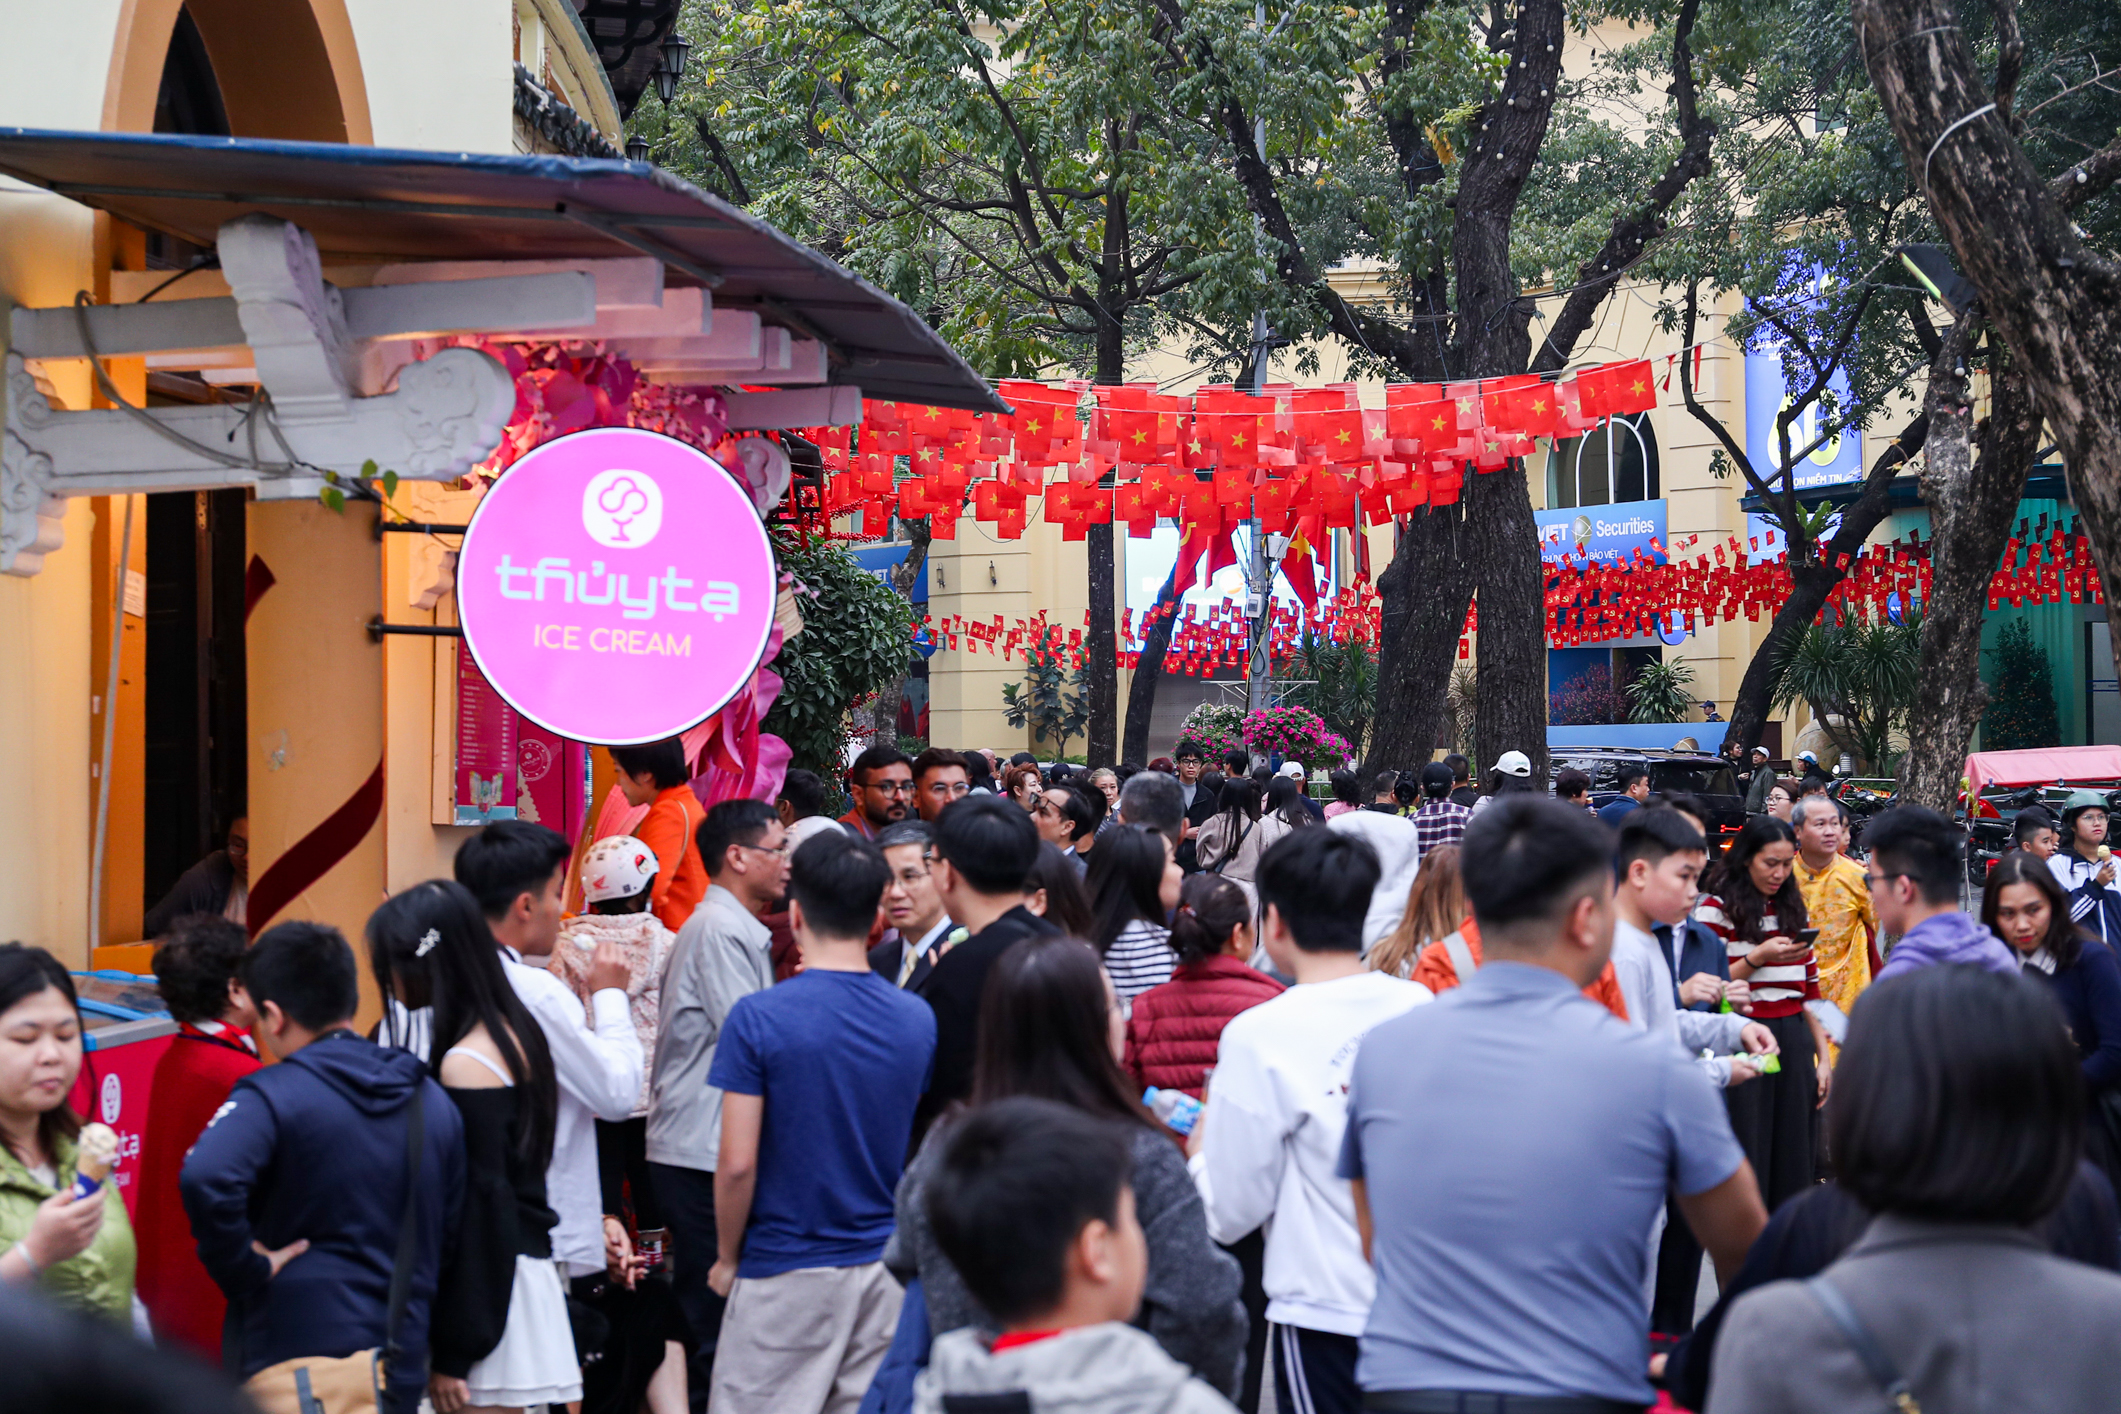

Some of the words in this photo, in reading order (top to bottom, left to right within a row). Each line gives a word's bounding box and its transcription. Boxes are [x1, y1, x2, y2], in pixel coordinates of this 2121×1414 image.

[1793, 477, 1805, 488] ỌN
[1829, 474, 1843, 484] TIN
[1596, 517, 1655, 538] Securities
[1569, 551, 1588, 562] HON
[1589, 548, 1604, 561] BẢO
[1604, 548, 1619, 560] VIỆT
[534, 623, 582, 651] ICE
[589, 627, 692, 658] CREAM
